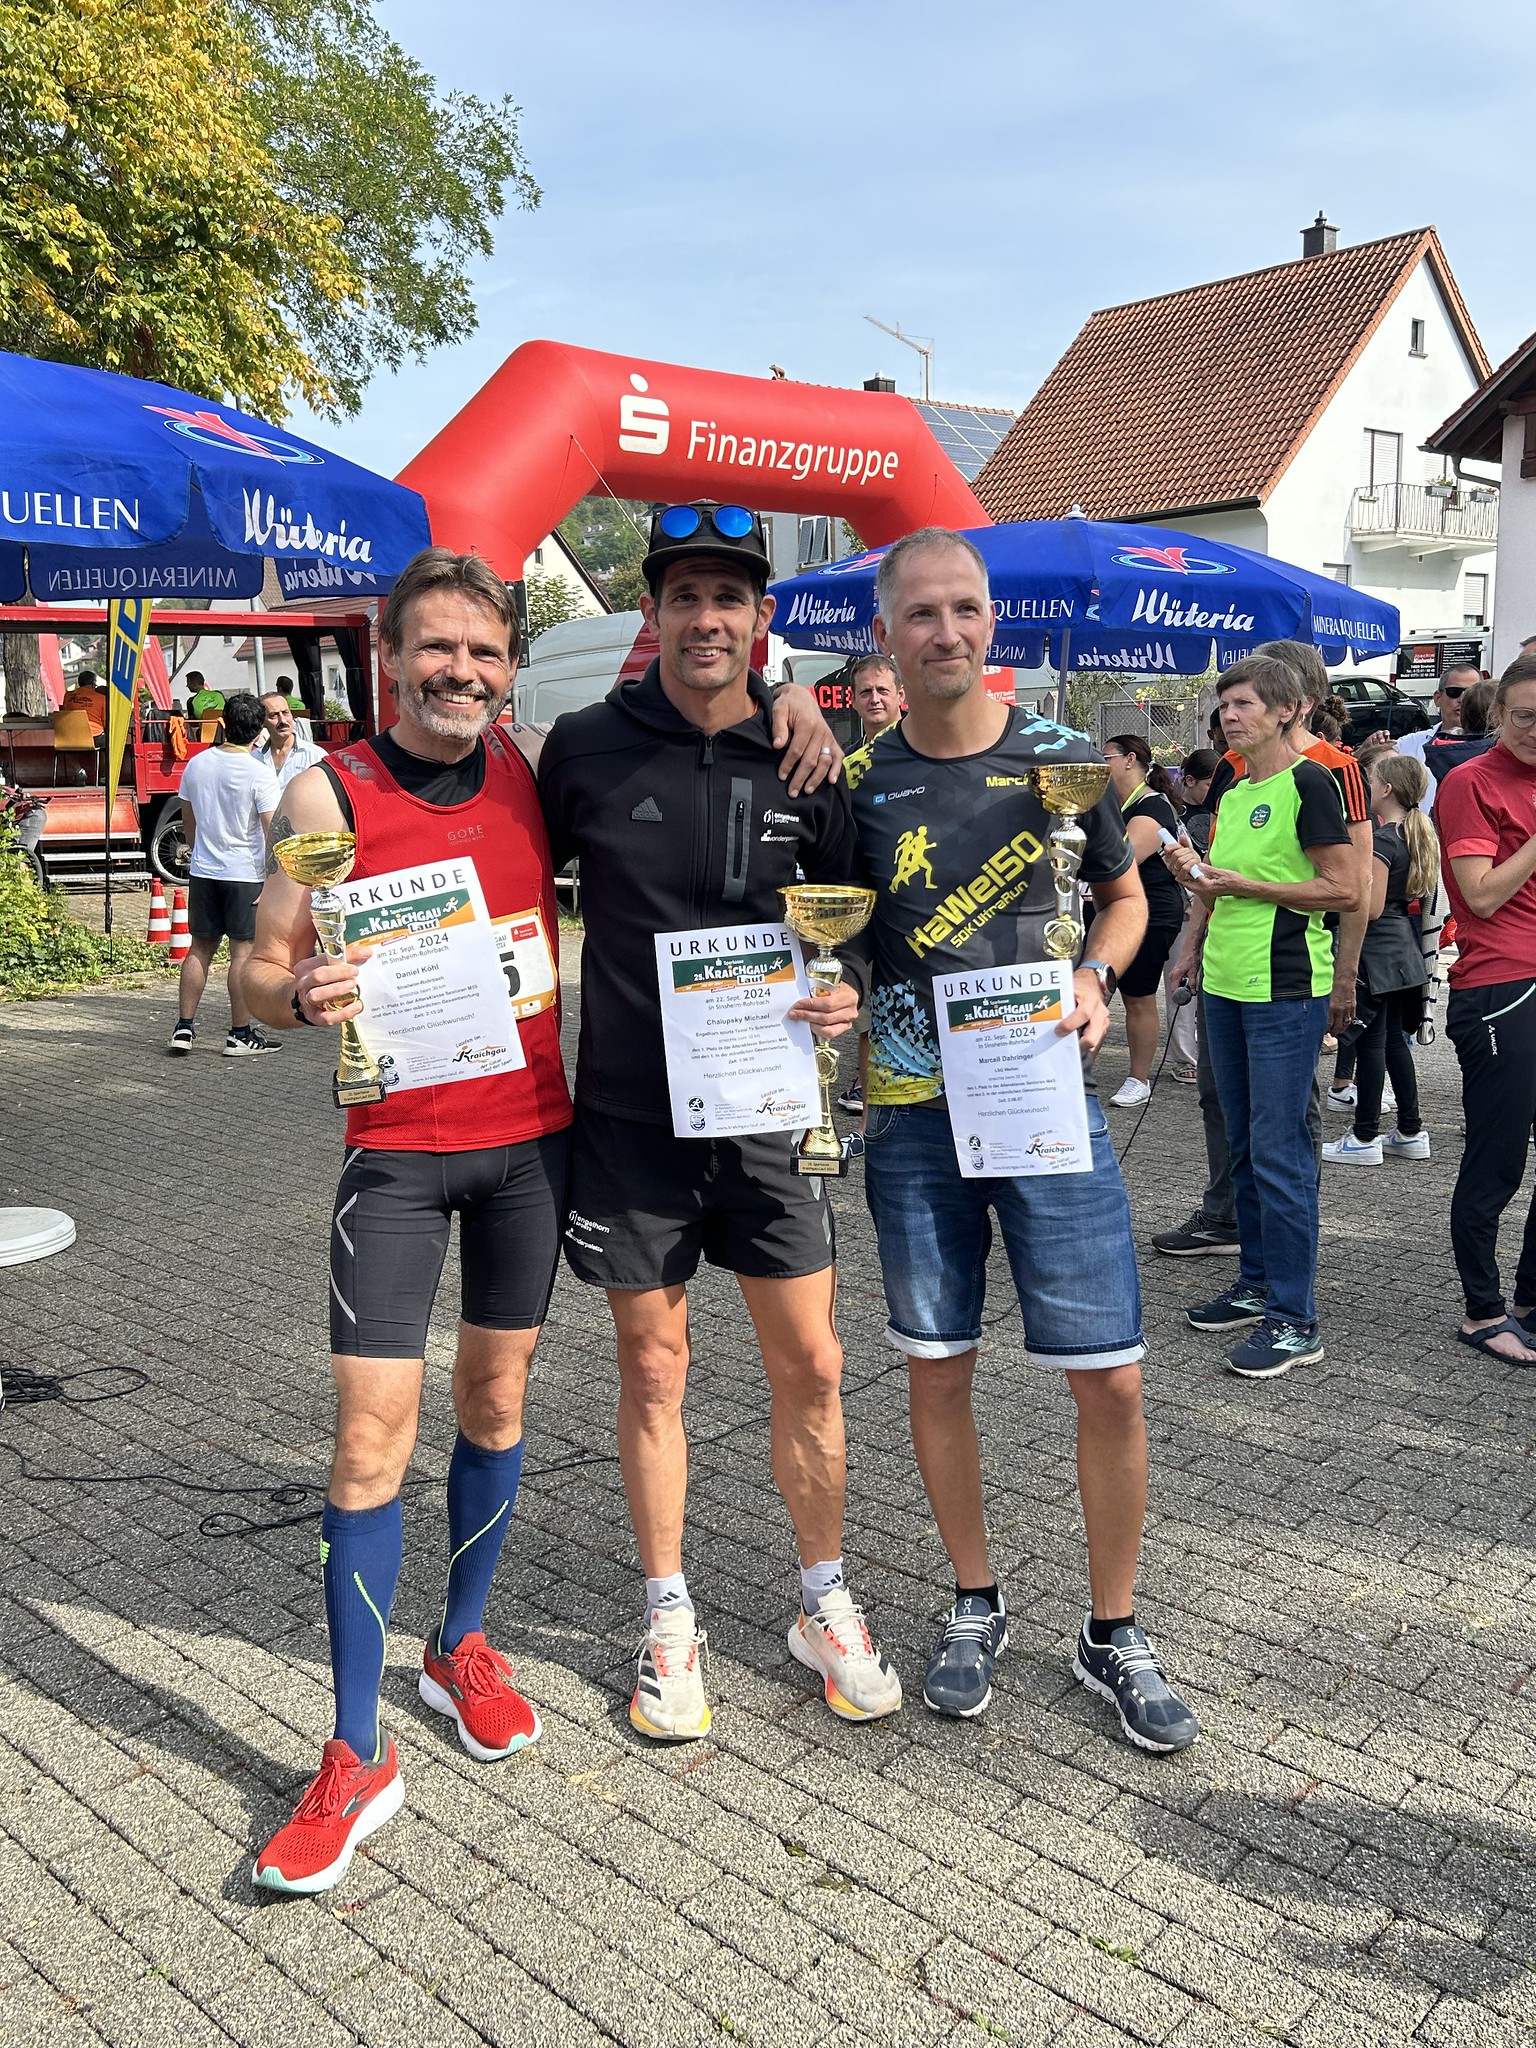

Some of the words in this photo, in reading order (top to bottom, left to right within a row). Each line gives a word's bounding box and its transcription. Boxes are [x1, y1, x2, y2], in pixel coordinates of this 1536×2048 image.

[687, 420, 899, 485] Finanzgruppe
[243, 487, 373, 563] Wüteria
[786, 592, 856, 626] Wüteria
[1131, 588, 1255, 632] Wüteria
[447, 824, 484, 841] GORE
[349, 869, 466, 908] RKUNDE
[905, 831, 1044, 959] HaWei50
[950, 922, 978, 949] 50K
[973, 880, 1029, 927] UltraRun
[409, 921, 438, 933] Lauf
[418, 933, 449, 949] 2024
[670, 932, 790, 956] URKUNDE
[396, 968, 420, 979] Daniel
[421, 963, 440, 973] Köhl
[739, 975, 763, 984] Lauf
[743, 988, 771, 999] 2024
[944, 971, 1060, 997] URKUNDE
[388, 1024, 426, 1037] Herzlichen
[426, 1012, 475, 1029] Glückwunsch!
[744, 1013, 770, 1021] Michael
[1004, 1014, 1028, 1023] Lauf
[1009, 1027, 1036, 1038] 2024
[1002, 1054, 1034, 1062] Dahringer
